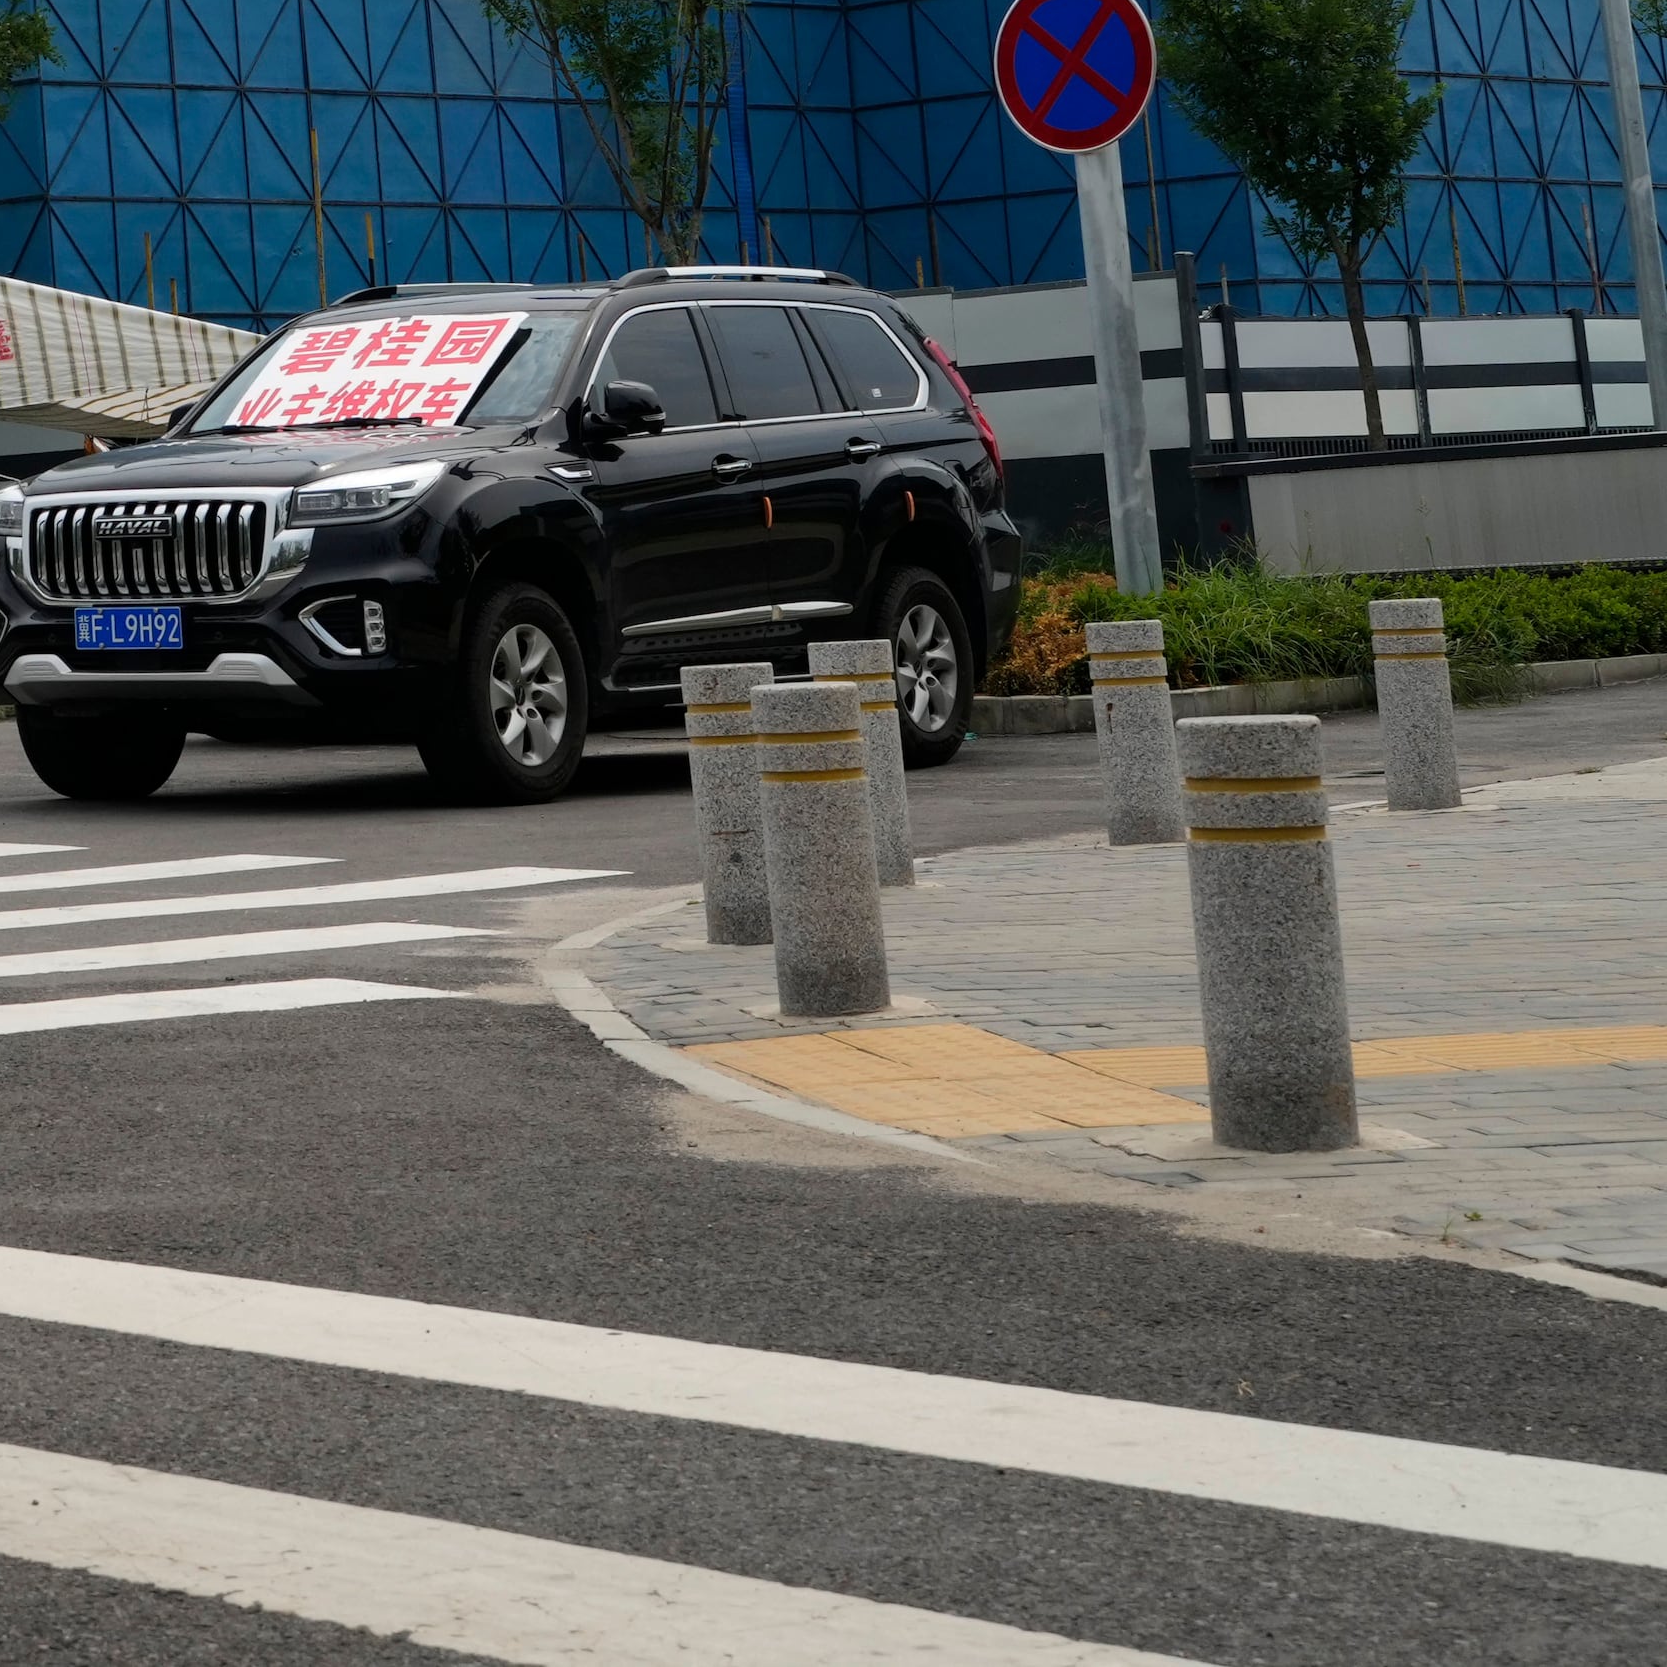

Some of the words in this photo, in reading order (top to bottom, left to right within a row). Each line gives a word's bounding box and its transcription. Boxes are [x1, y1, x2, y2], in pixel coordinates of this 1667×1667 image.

[279, 318, 511, 376] 碧桂园
[238, 377, 471, 429] 业主维权车
[99, 521, 166, 535] HAVAL
